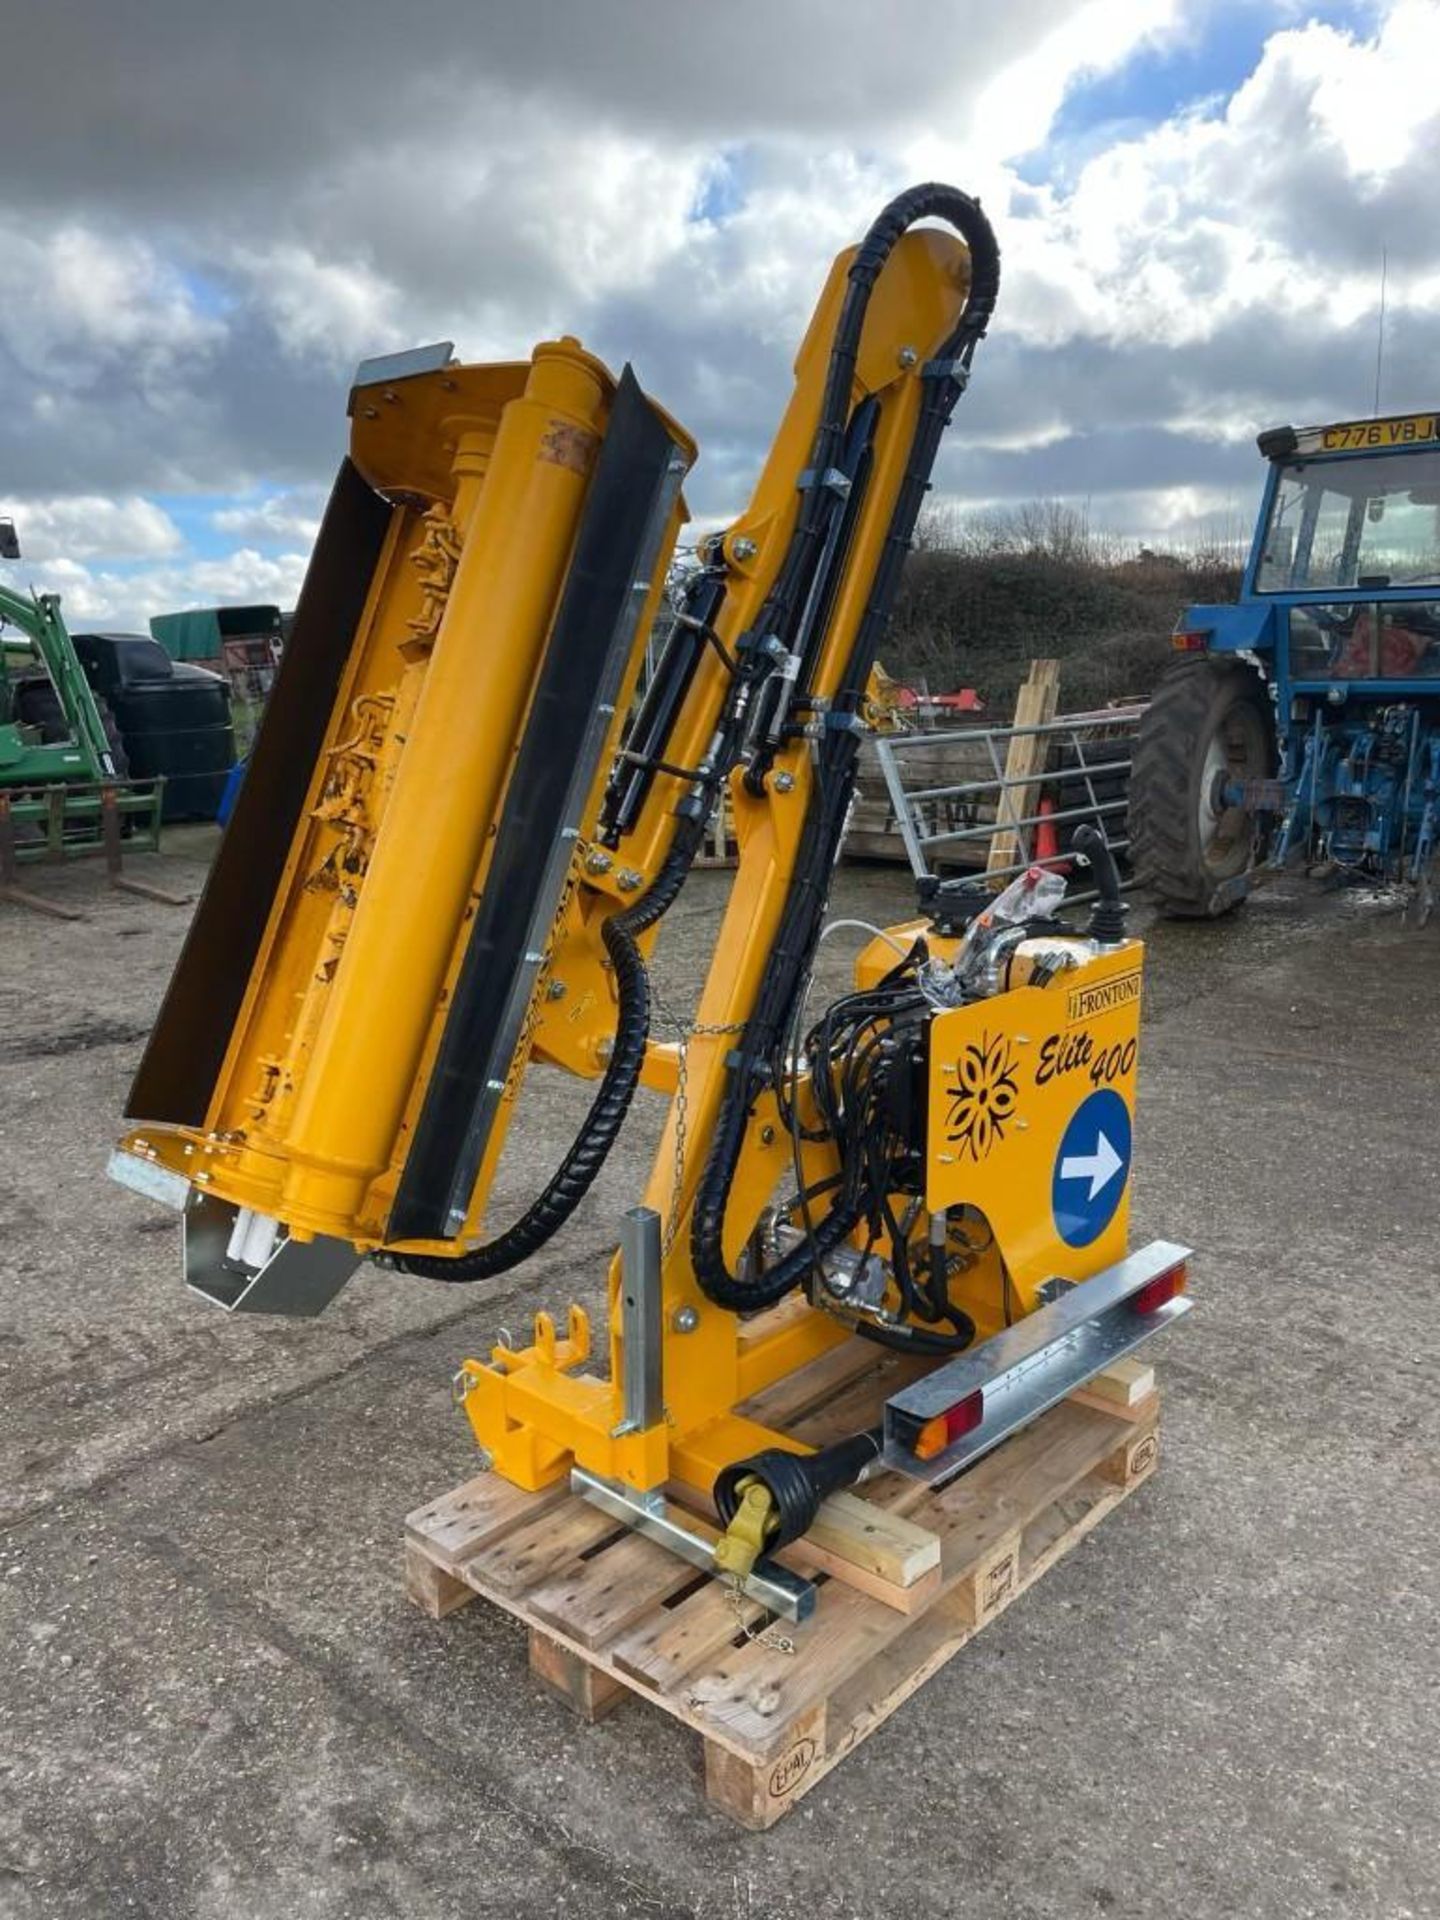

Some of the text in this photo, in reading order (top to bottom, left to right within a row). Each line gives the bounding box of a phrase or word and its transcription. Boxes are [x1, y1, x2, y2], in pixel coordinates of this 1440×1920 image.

[1323, 425, 1381, 449] C776
[1035, 1031, 1137, 1086] Elite 400
